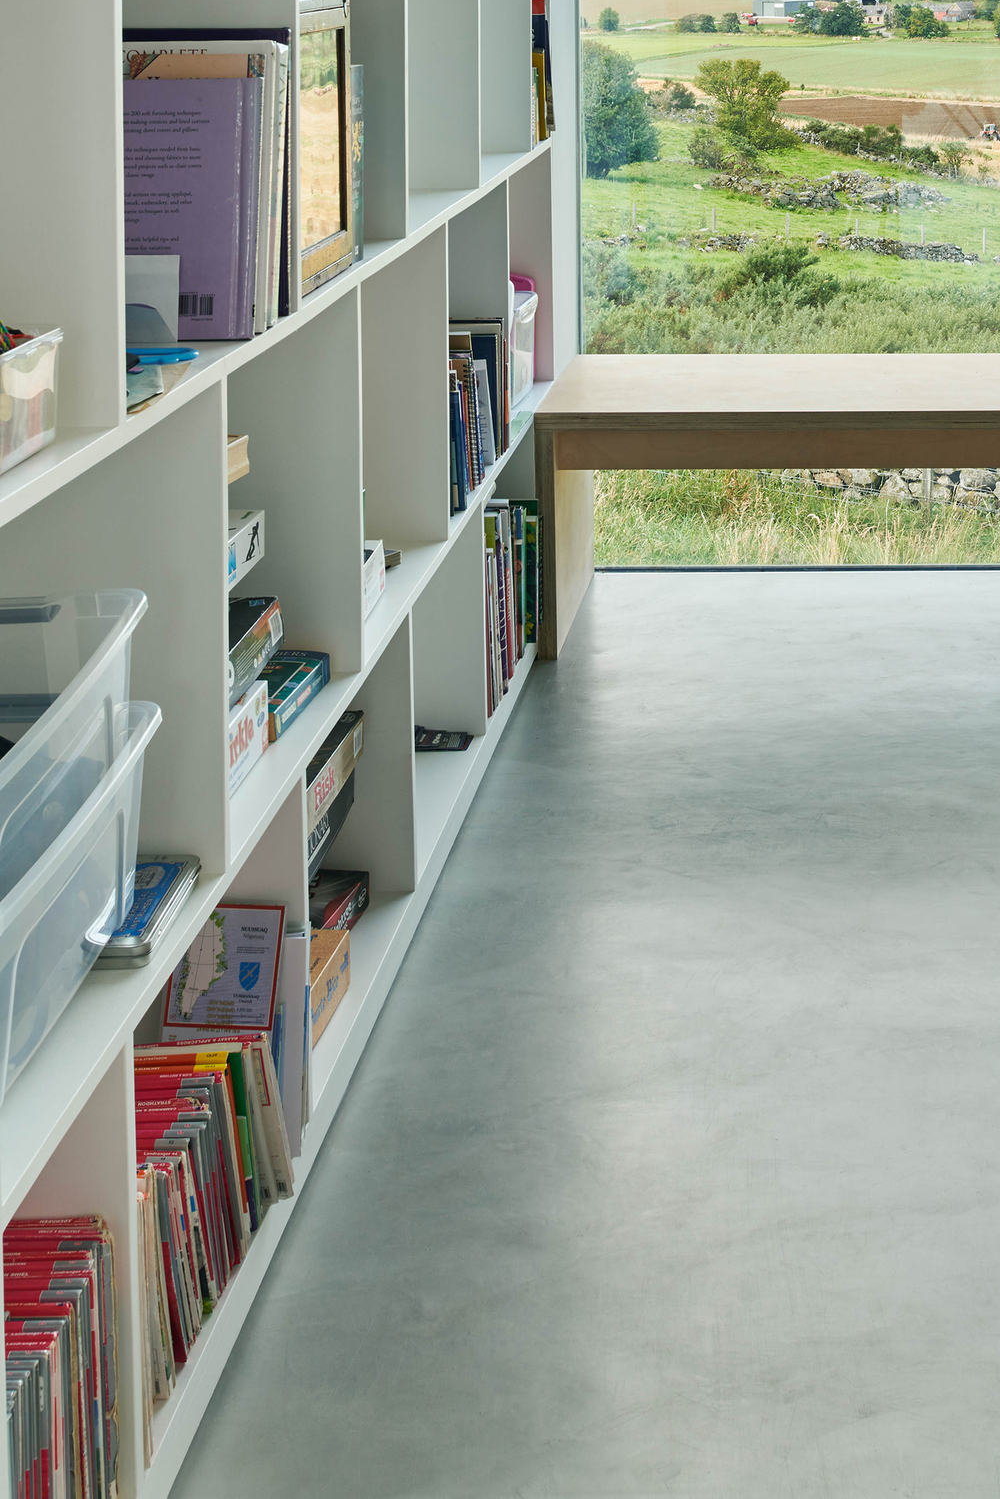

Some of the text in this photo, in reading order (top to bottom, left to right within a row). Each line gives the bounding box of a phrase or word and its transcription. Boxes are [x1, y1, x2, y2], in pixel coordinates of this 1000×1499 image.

[151, 110, 176, 118] furnishing
[313, 764, 336, 812] Risk
[176, 1038, 210, 1046] APPLECROSS
[217, 1035, 239, 1043] RAASAY
